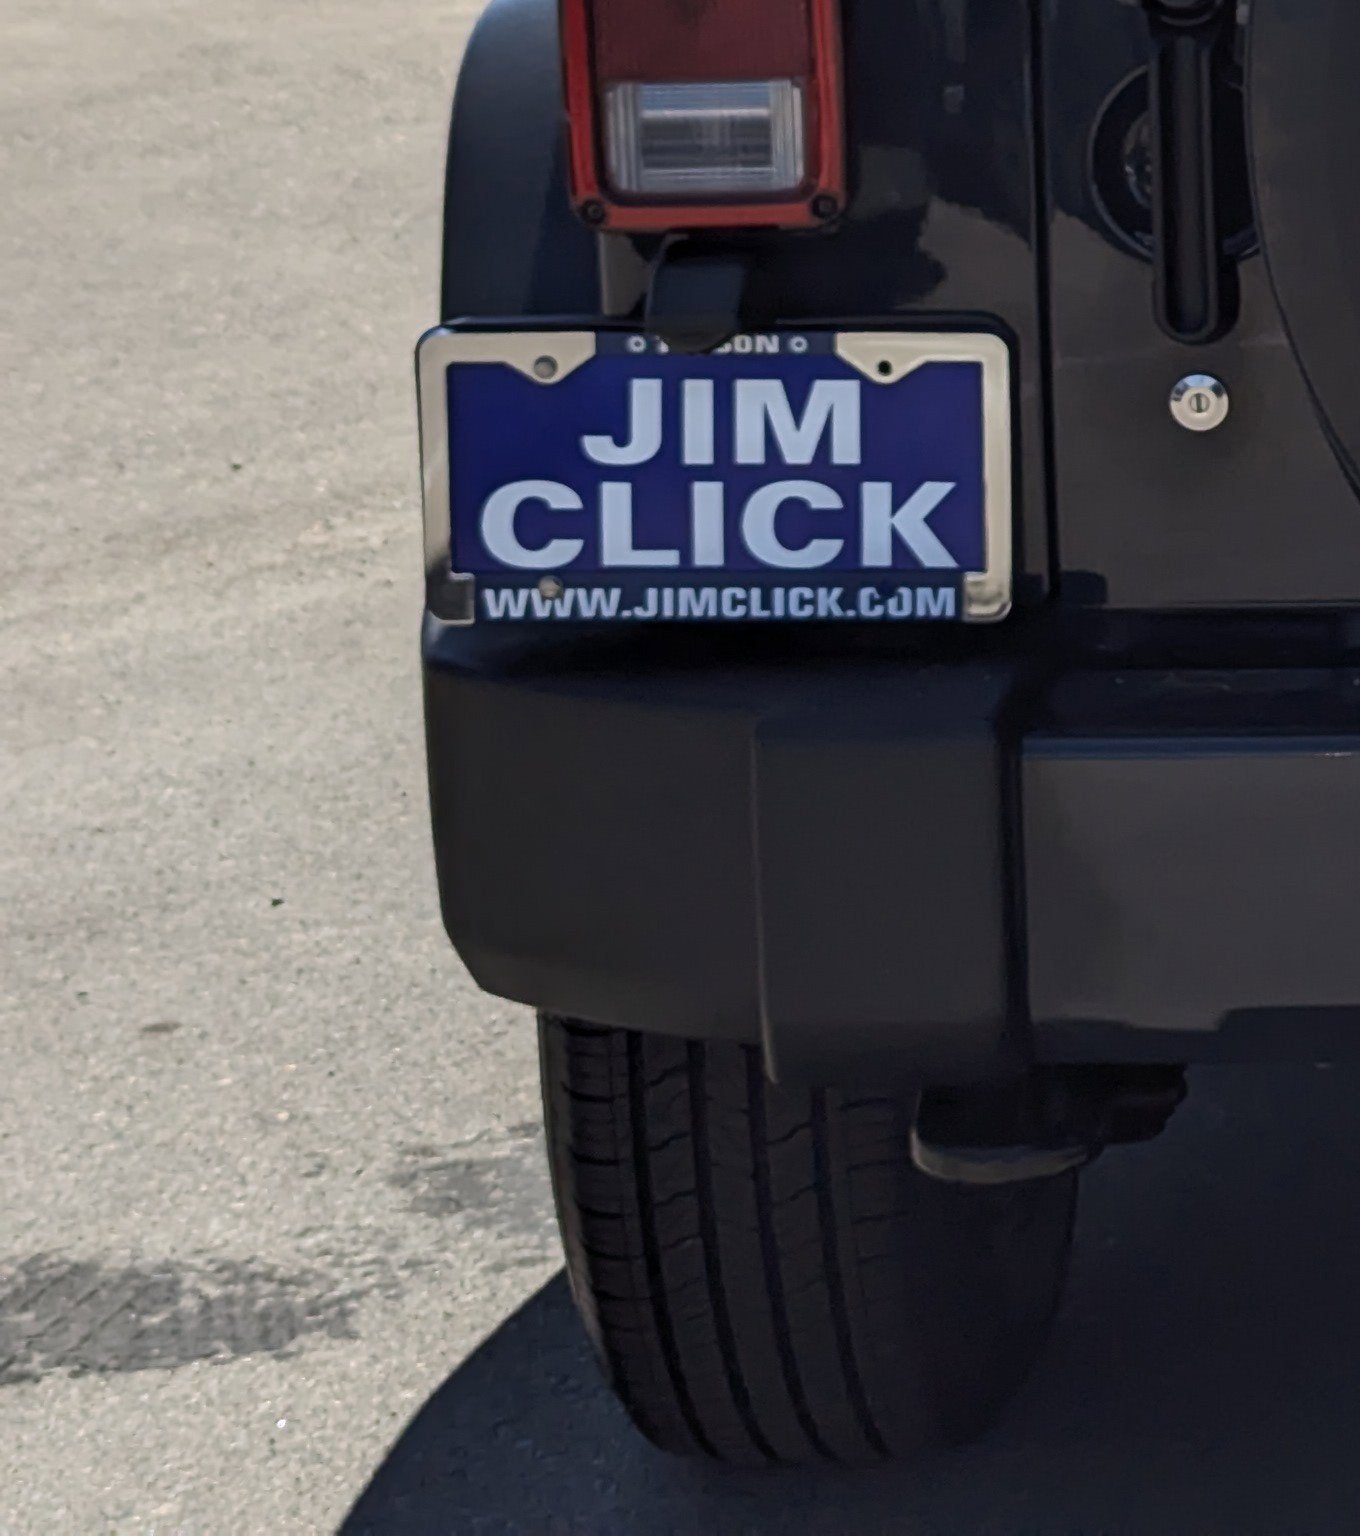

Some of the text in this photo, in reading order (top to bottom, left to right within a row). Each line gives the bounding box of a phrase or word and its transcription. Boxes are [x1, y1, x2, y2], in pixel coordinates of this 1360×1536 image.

[581, 378, 862, 466] JIM
[480, 478, 959, 570] CLICK
[483, 586, 957, 619] WWW.JIMCLICK.COM
